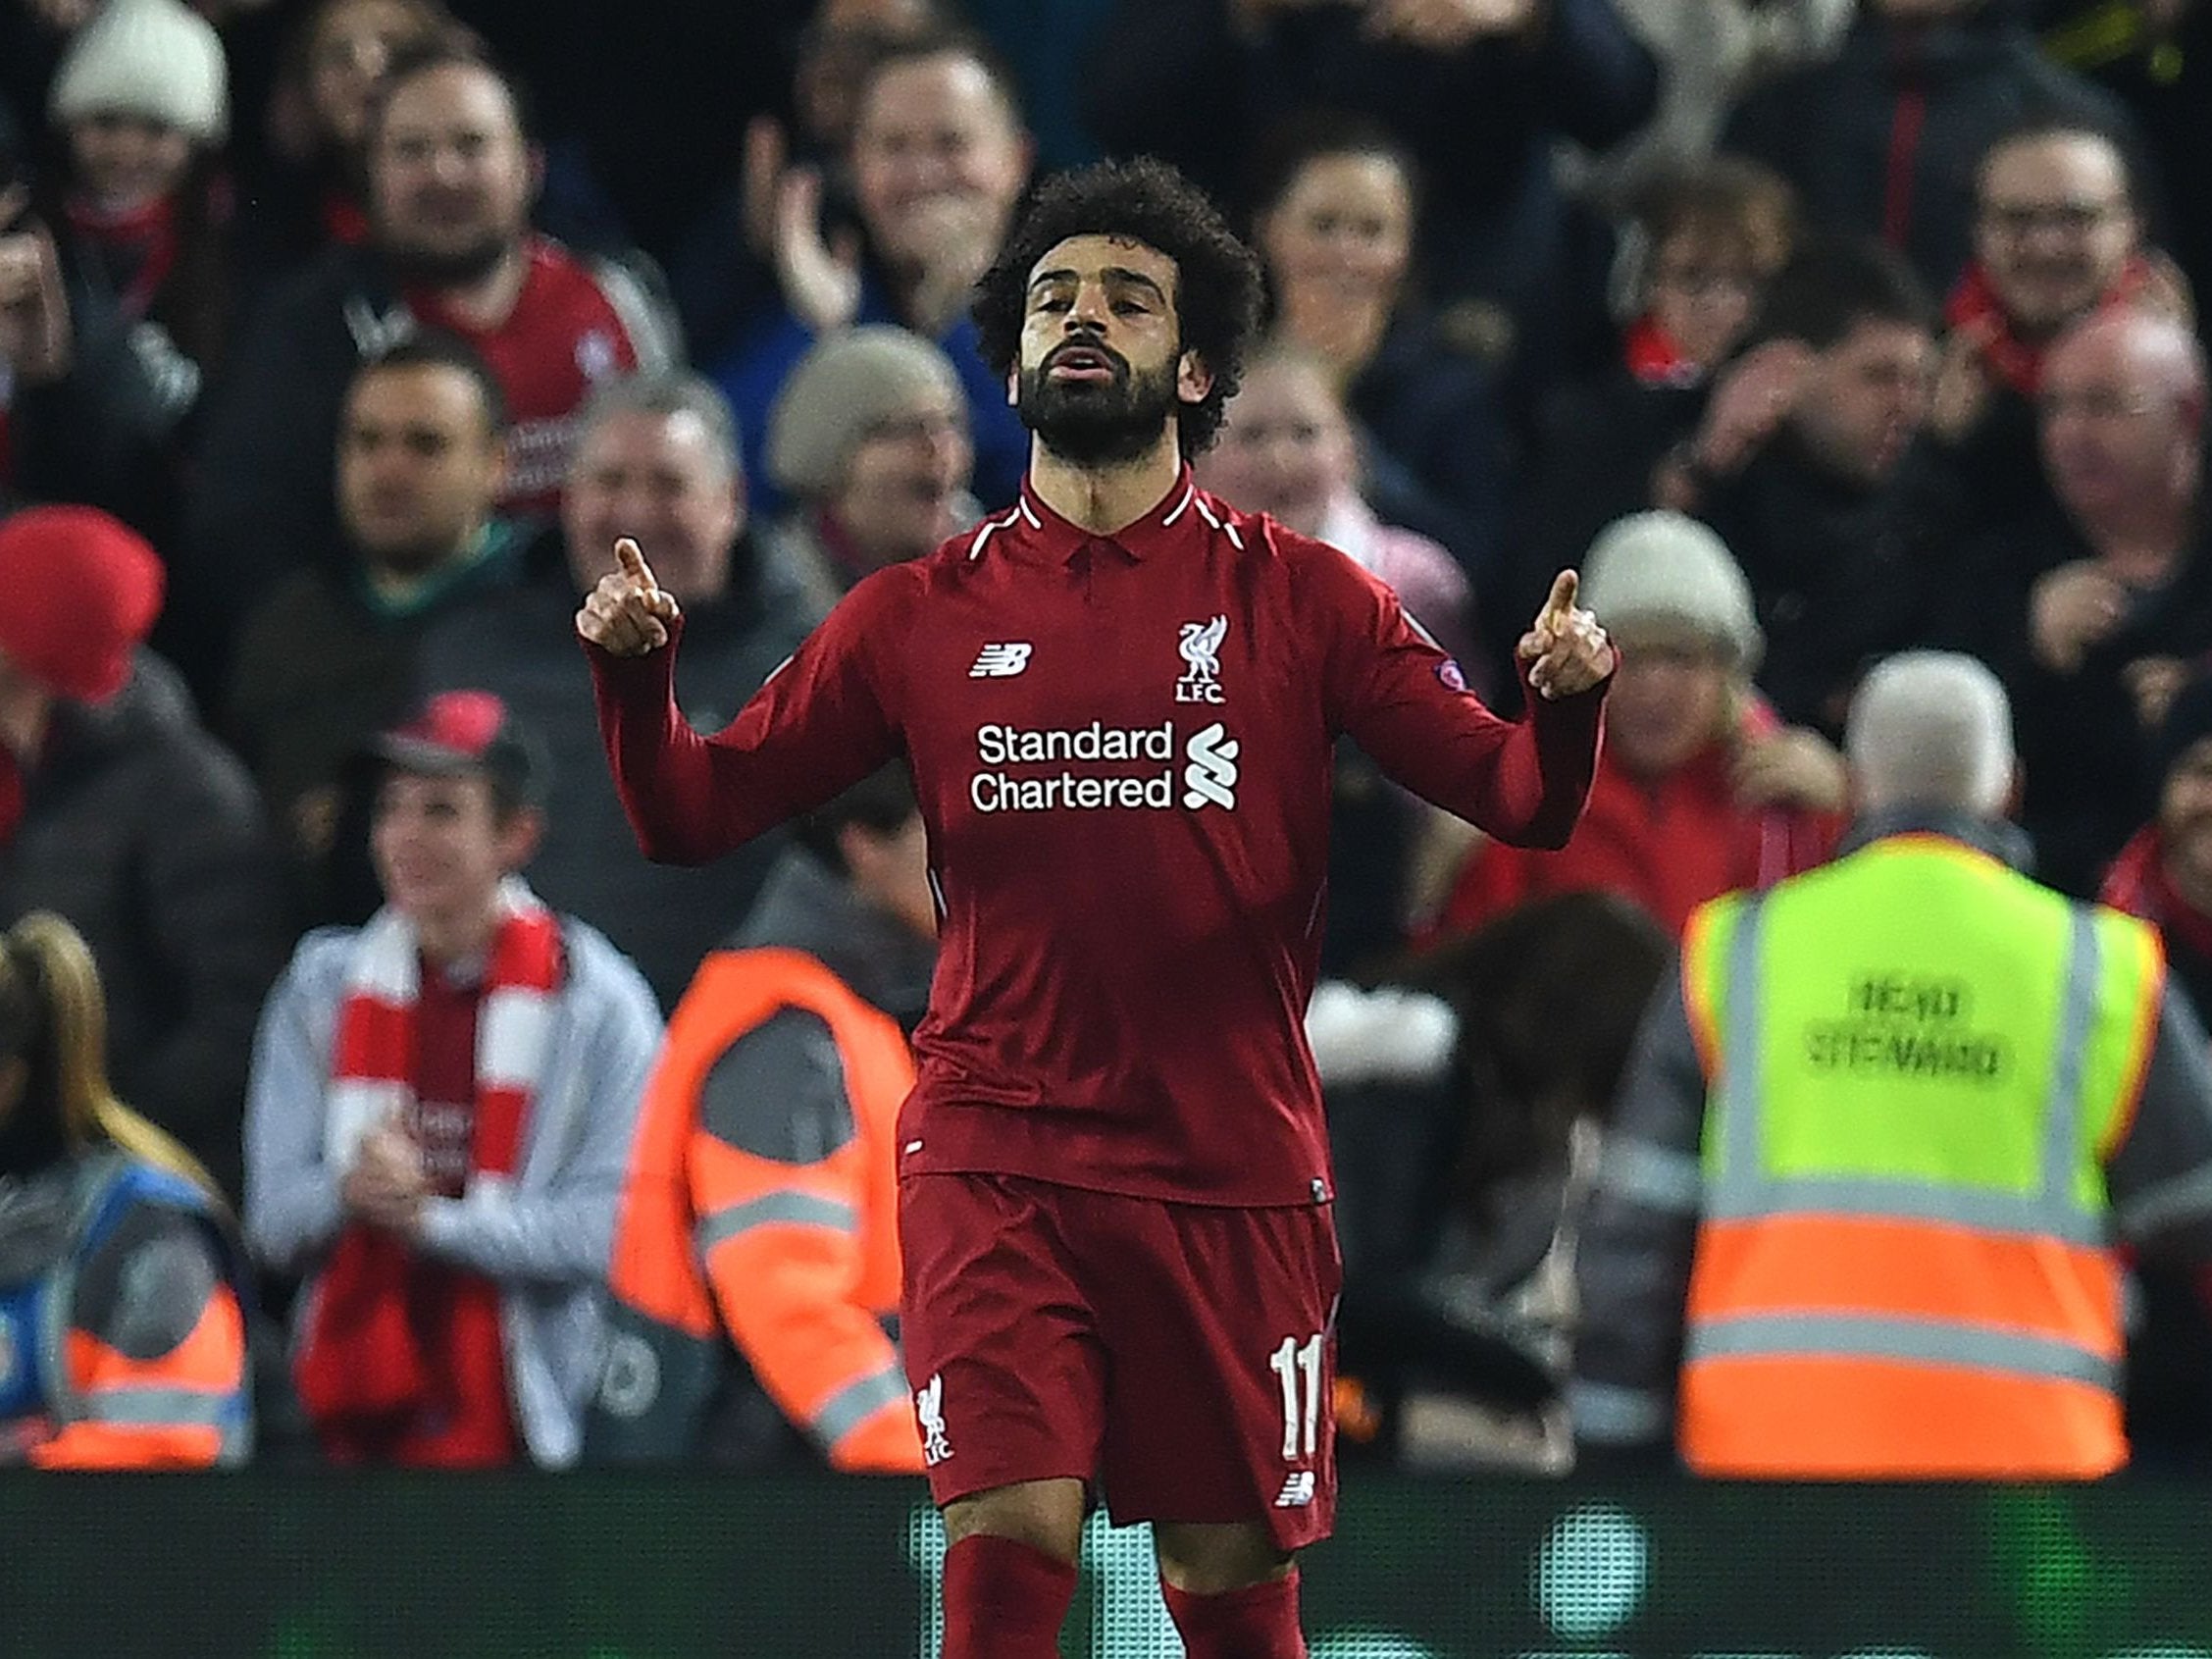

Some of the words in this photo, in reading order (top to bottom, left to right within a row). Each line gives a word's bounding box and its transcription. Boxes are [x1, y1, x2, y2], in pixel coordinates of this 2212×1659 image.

[1175, 683, 1226, 703] LFC
[978, 721, 1172, 763] Standard
[971, 769, 1171, 811] Chartered
[1270, 1334, 1322, 1461] 11
